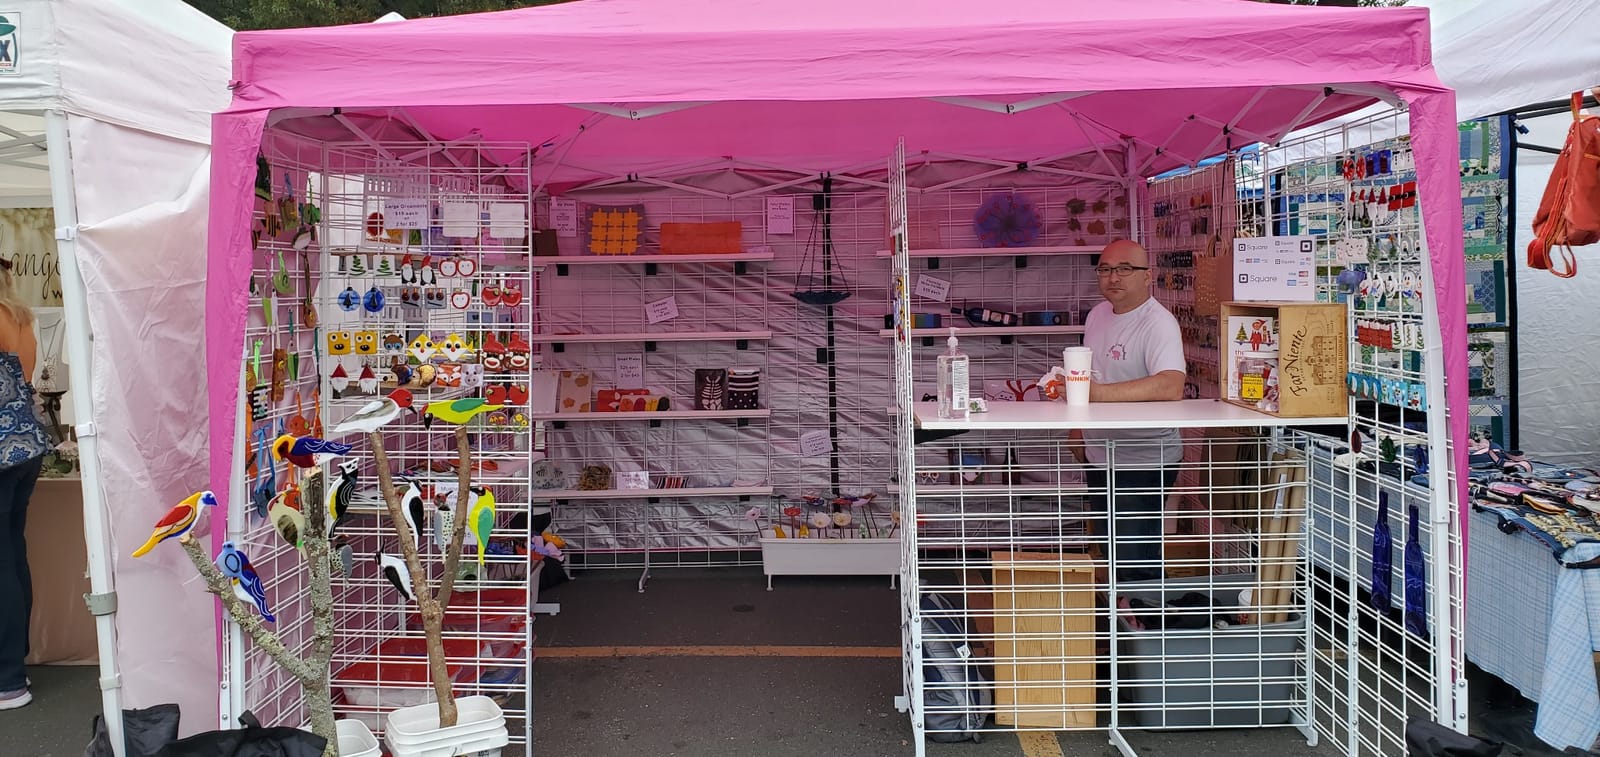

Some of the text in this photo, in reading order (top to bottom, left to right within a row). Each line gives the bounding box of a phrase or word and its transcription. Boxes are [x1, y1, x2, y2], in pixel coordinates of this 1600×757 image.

[1250, 274, 1277, 283] Square
[1283, 325, 1307, 396] Far Niente
